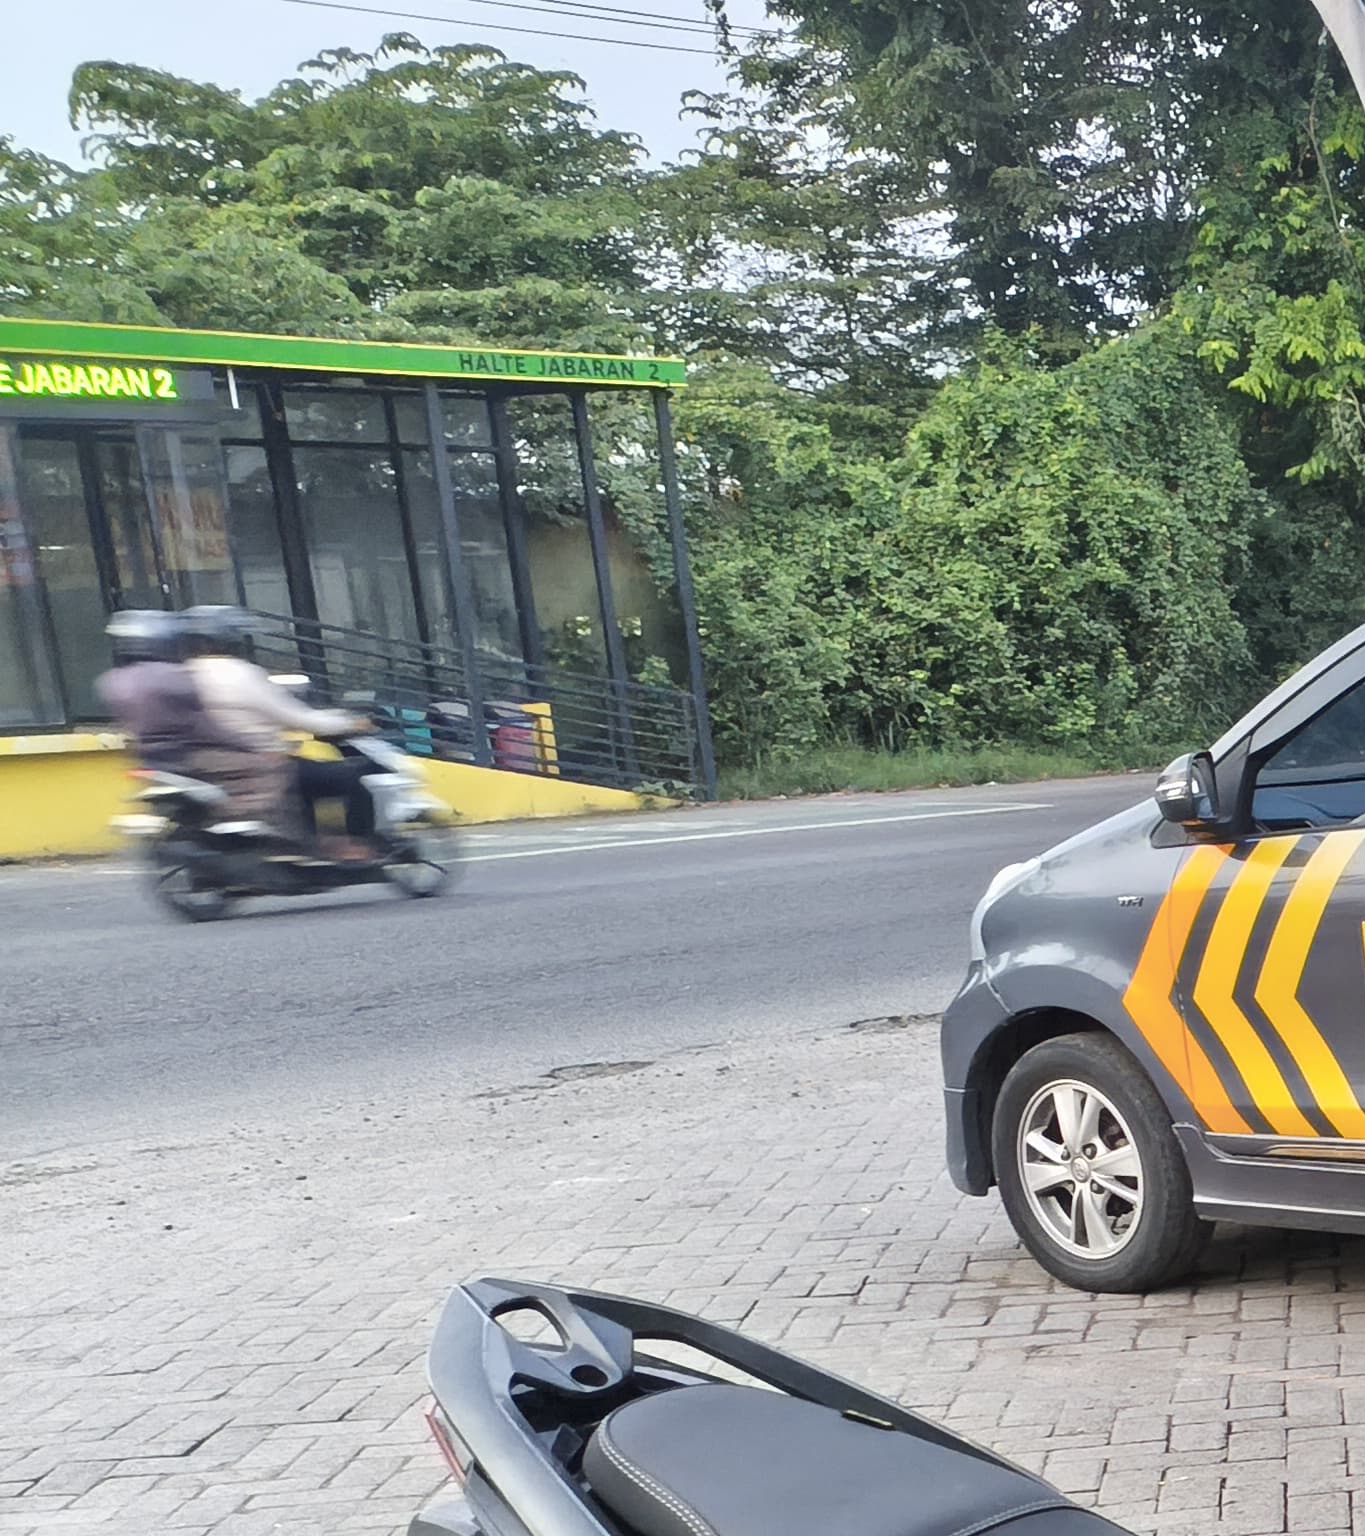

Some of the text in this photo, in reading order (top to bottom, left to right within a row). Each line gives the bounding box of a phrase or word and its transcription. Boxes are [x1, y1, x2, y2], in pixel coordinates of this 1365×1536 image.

[15, 361, 152, 398] JABARAN
[152, 367, 178, 398] 2
[458, 352, 660, 380] HALTE JABARAN 2
